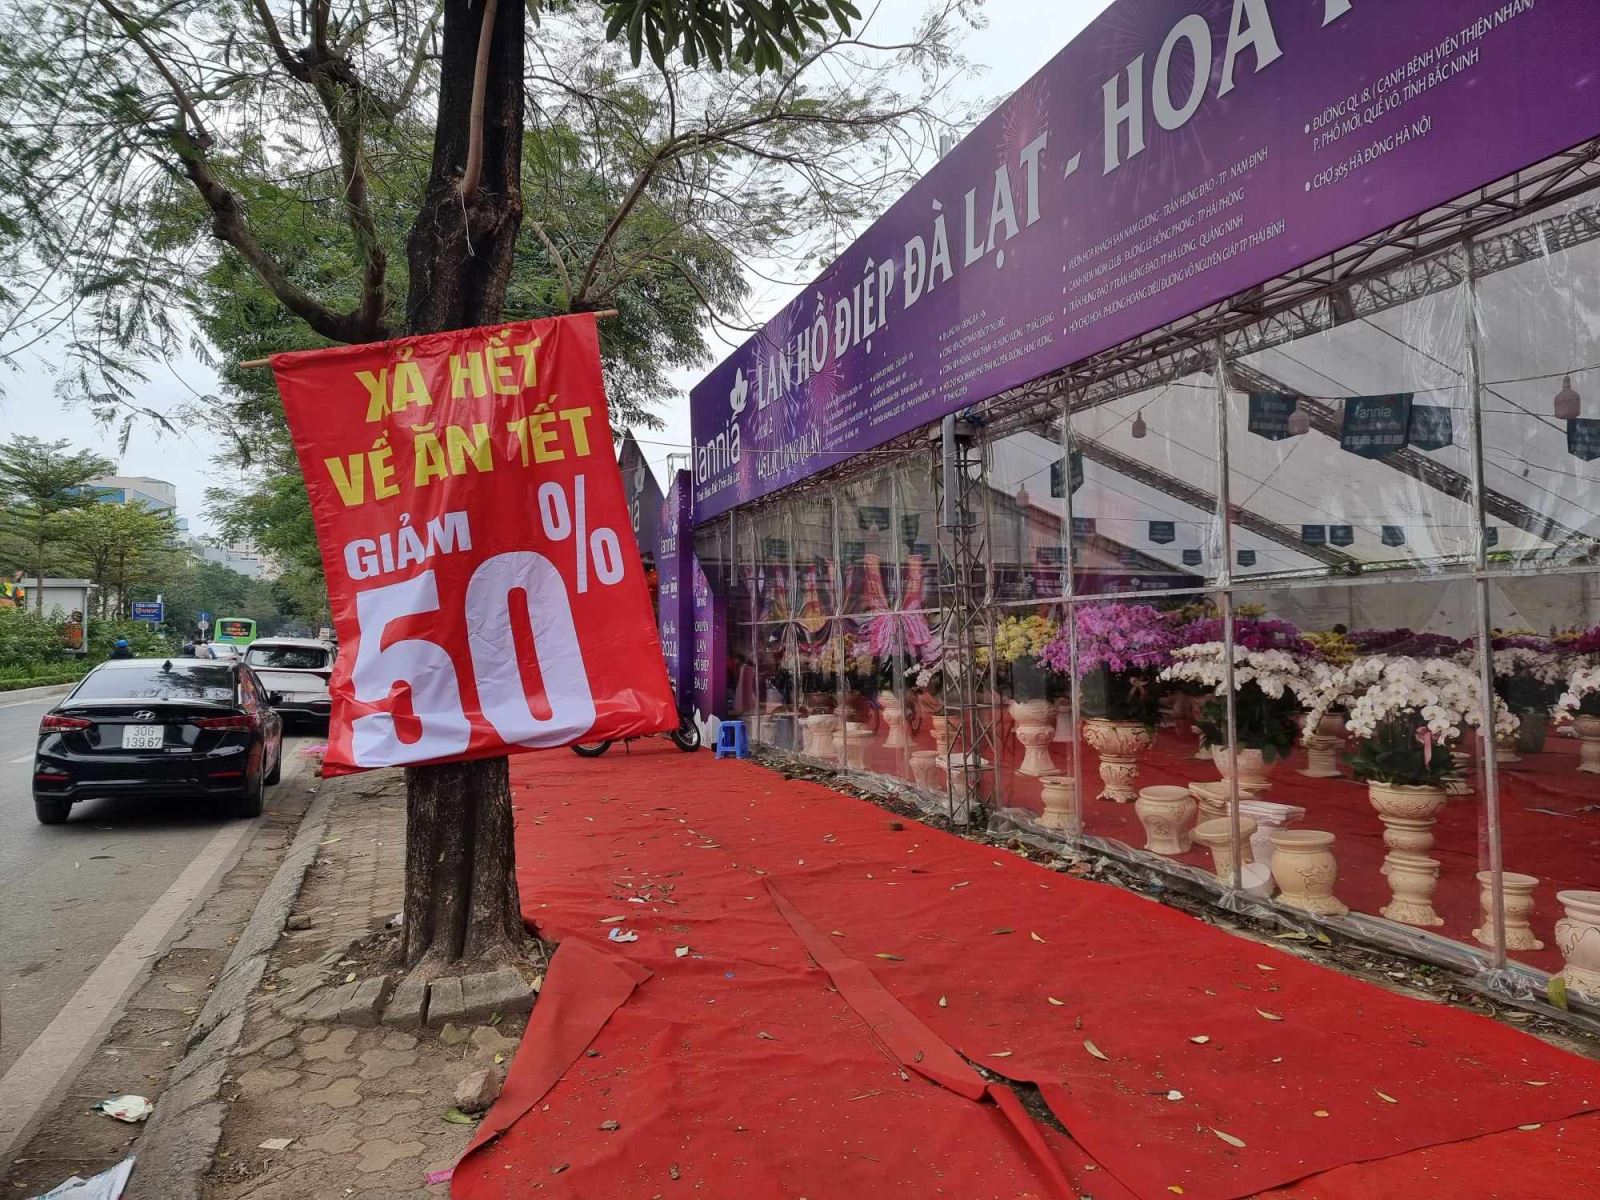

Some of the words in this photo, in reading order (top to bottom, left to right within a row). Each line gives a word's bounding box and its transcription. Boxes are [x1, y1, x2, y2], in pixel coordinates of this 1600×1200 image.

[1407, 50, 1434, 78] BỆNH
[1435, 34, 1459, 59] VIỆN
[1460, 15, 1492, 46] THIỆN
[1428, 63, 1450, 88] BẮC
[1451, 48, 1480, 76] NINH
[1230, 160, 1249, 178] NAM
[1313, 167, 1334, 188] CHỢ
[1333, 163, 1348, 183] 365
[1350, 150, 1364, 171] HÀ
[1364, 136, 1395, 163] ĐÔNG
[1395, 125, 1411, 146] HÀ
[1412, 115, 1432, 138] NỘI
[757, 344, 792, 411] LAN
[797, 291, 829, 386] HỒ
[835, 257, 895, 359] ĐIỆP
[903, 198, 954, 310] ĐÀ
[963, 130, 1048, 269] LẠT
[1102, 0, 1284, 177] HOA
[1225, 214, 1245, 233] NINH
[1266, 219, 1285, 240] BÌNH
[354, 346, 432, 424] XẢ
[451, 329, 541, 399] HẾT
[324, 430, 400, 508] VỀ
[411, 422, 494, 487] ĂN
[343, 511, 472, 580] GIẢM
[133, 726, 155, 736] 30G
